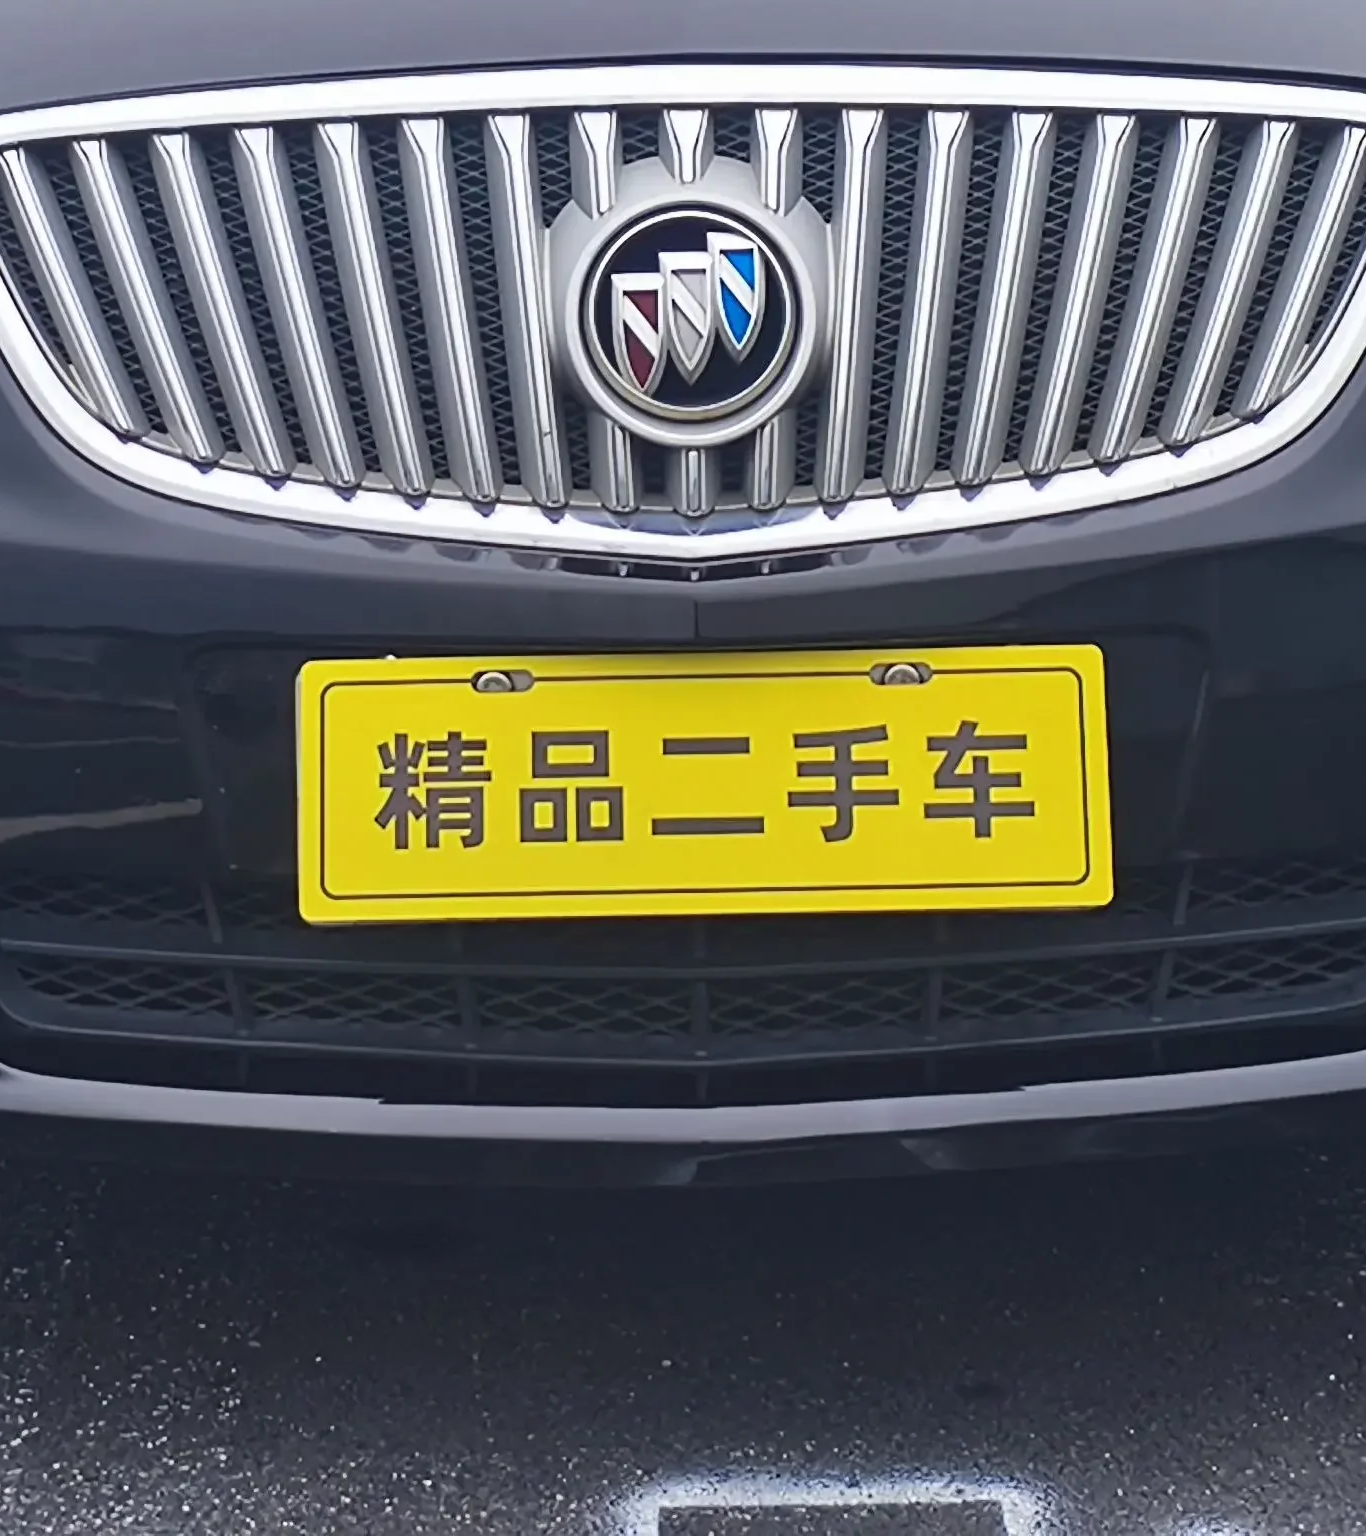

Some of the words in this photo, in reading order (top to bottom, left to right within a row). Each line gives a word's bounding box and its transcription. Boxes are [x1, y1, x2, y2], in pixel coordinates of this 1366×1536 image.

[373, 719, 1037, 850] 精品二手车
